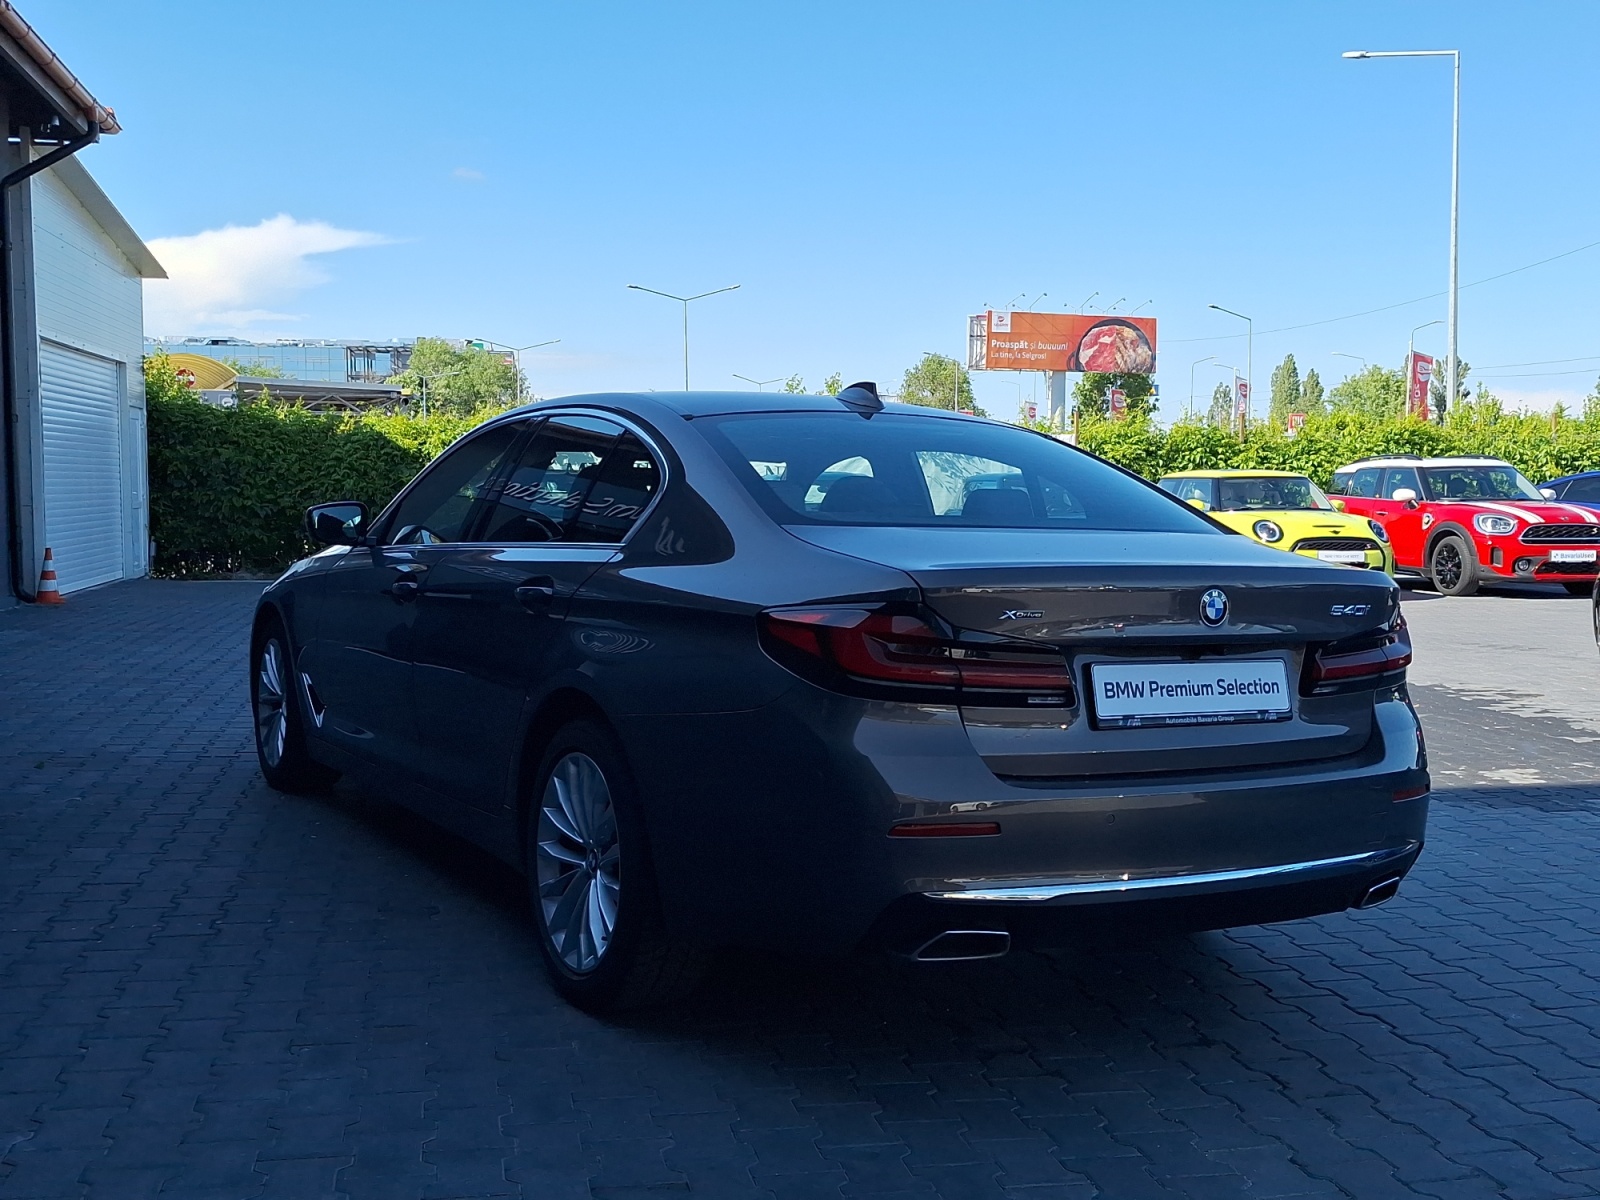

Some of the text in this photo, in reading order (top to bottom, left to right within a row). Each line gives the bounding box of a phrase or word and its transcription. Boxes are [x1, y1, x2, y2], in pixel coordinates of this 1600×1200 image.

[991, 339, 1028, 350] Proaspăt
[1000, 350, 1014, 359] tine,
[1022, 351, 1047, 360] Selgros!
[1103, 678, 1280, 699] BMW Premium Selection
